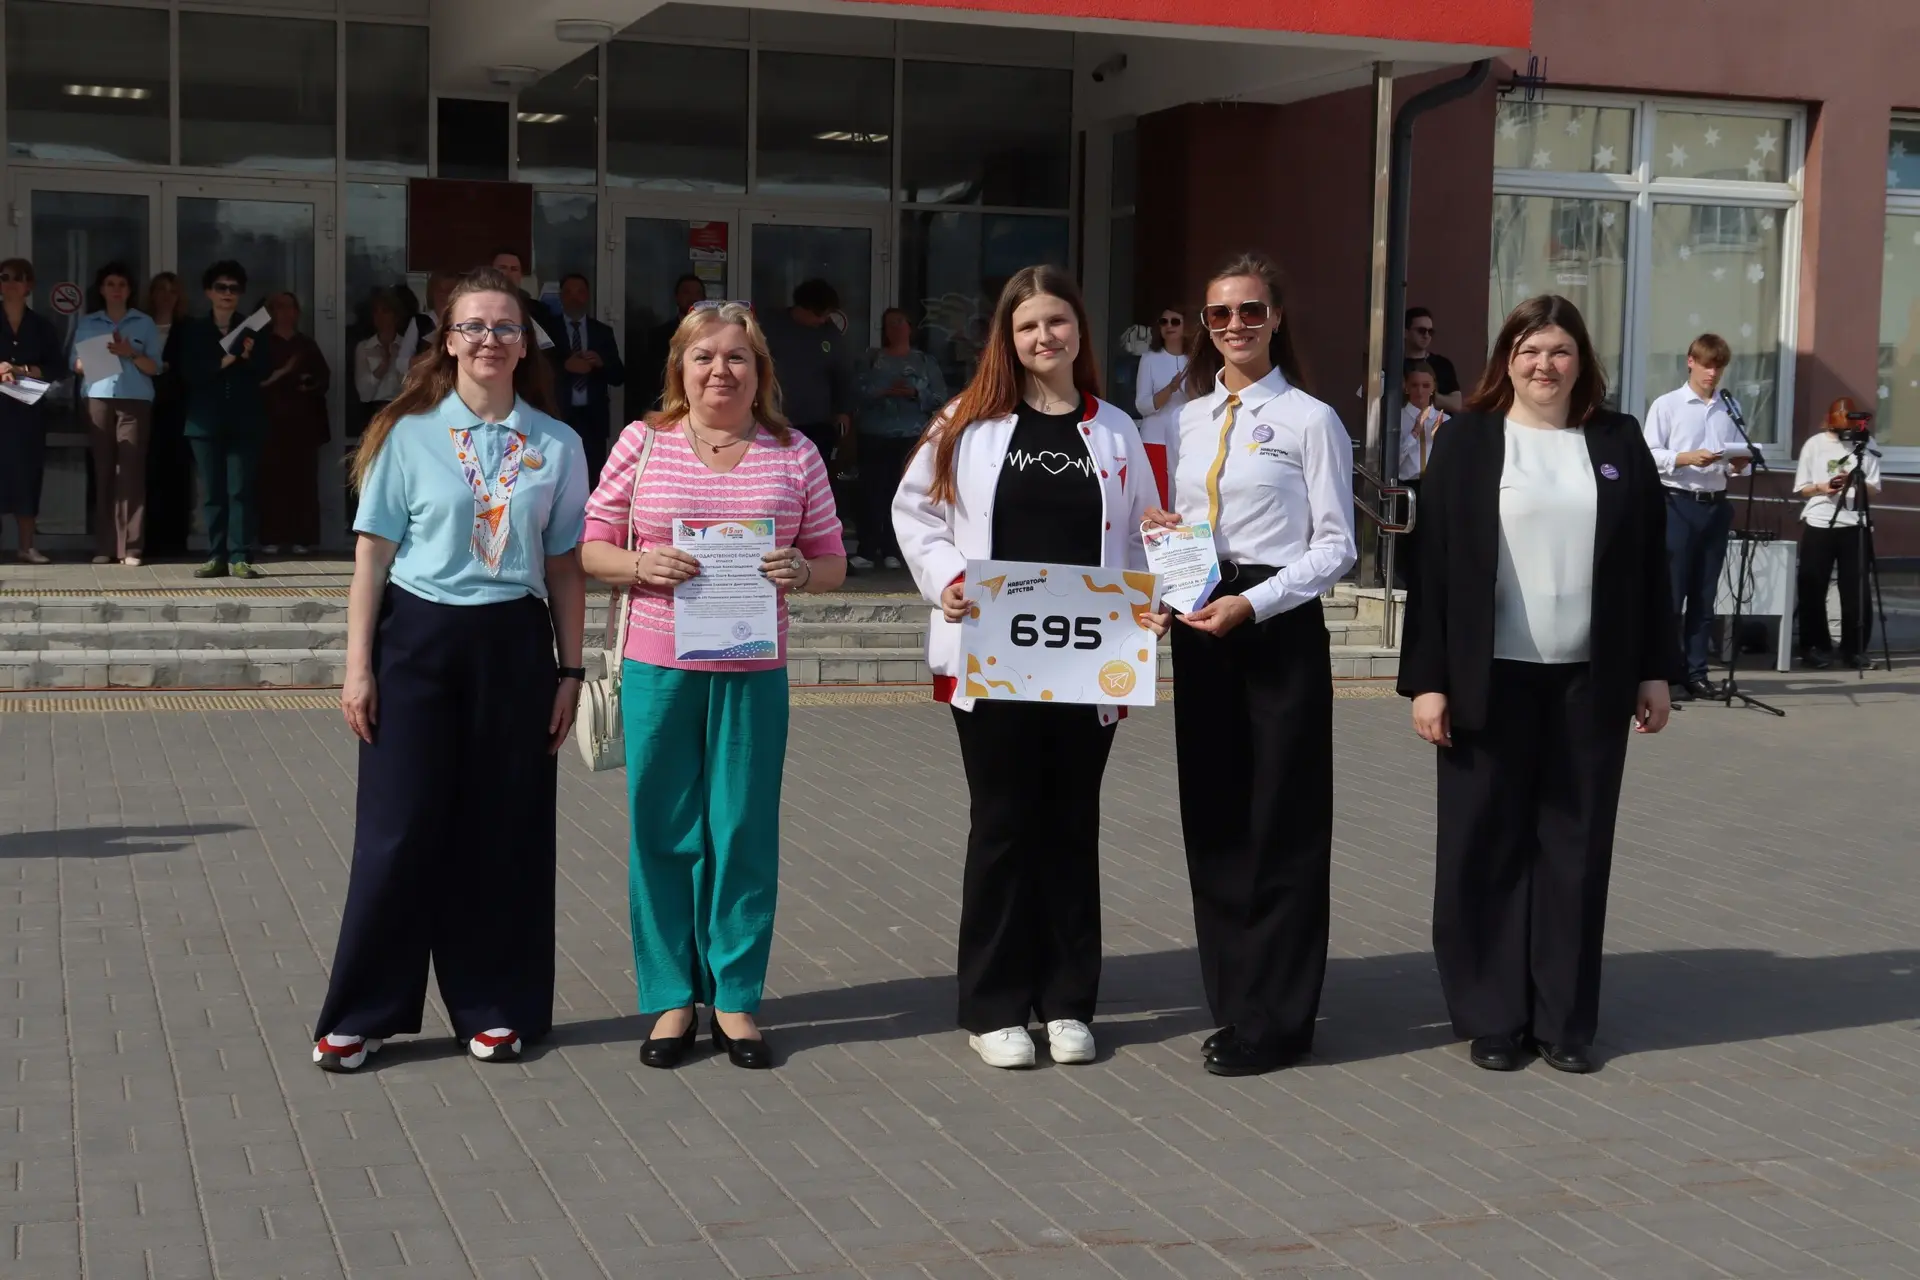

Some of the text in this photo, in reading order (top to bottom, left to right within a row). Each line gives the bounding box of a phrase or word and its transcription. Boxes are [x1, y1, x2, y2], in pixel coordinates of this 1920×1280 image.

[1007, 577, 1047, 588] НАВИГАТОРЫ
[1007, 586, 1034, 595] ДЕТСТВА
[1010, 613, 1102, 650] 695
